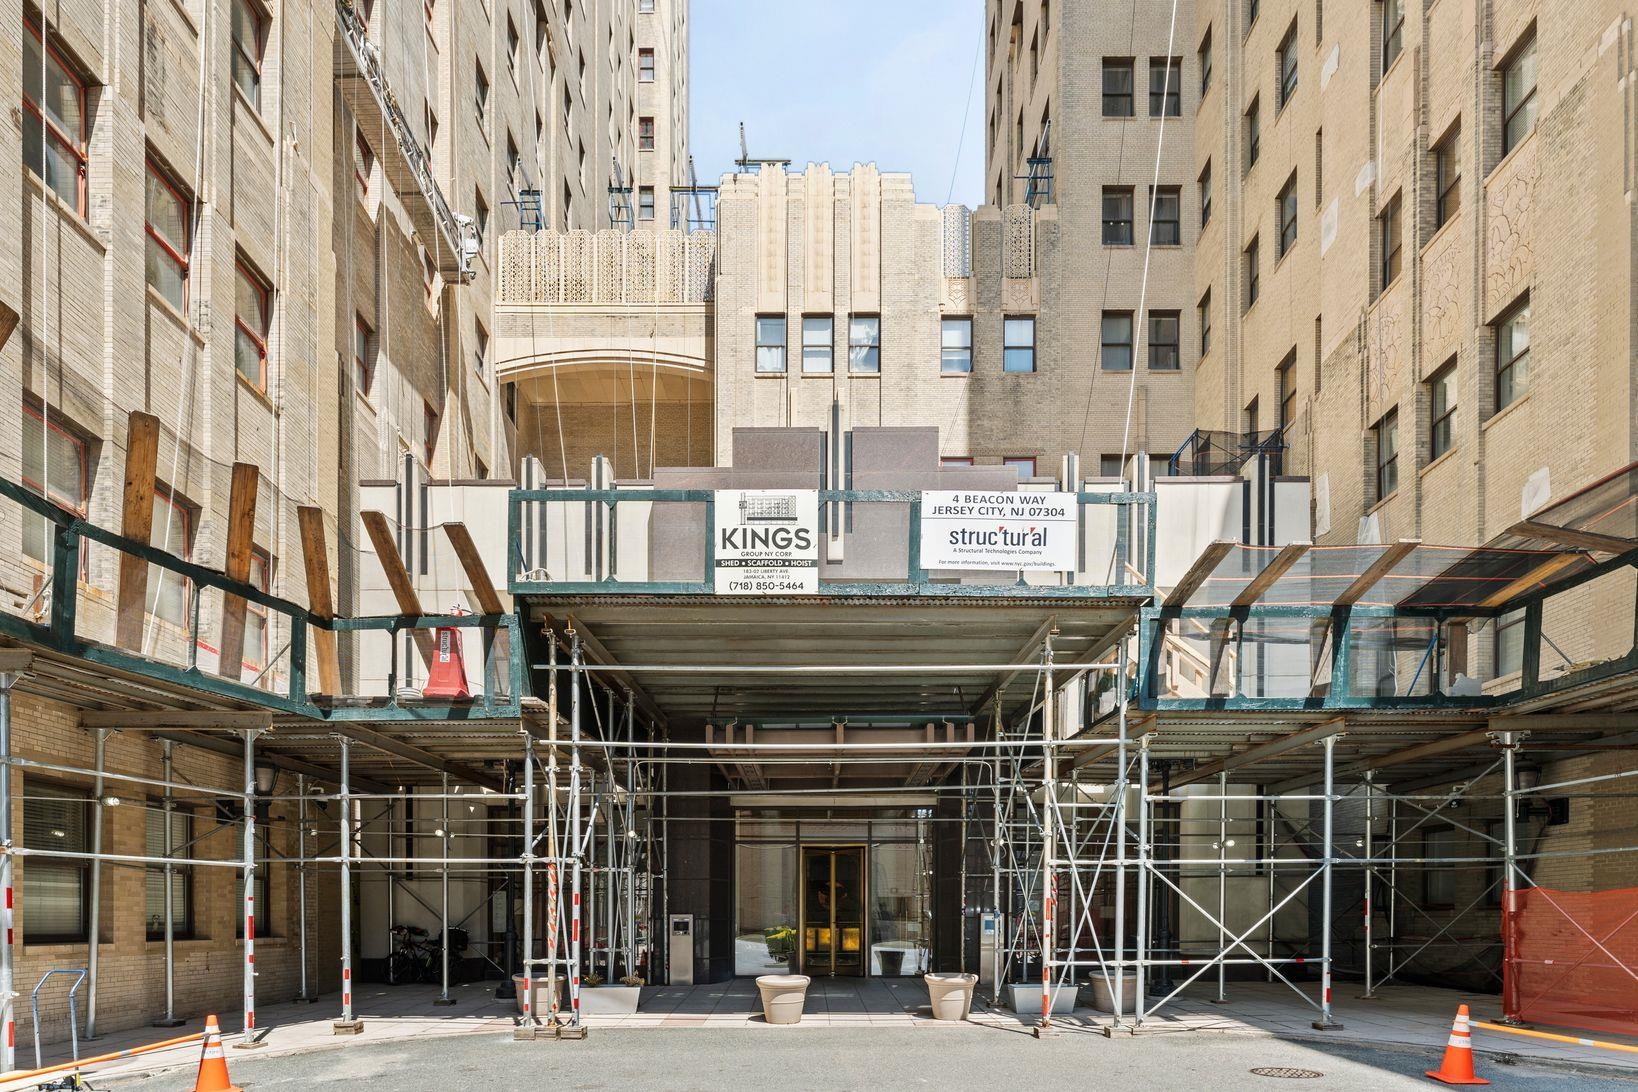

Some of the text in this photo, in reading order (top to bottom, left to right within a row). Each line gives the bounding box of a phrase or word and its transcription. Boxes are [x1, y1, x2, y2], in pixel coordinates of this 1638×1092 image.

[952, 494, 1047, 505] 4 BEACON WAY
[932, 506, 1065, 517] JERSEY CITY, NJ 07304
[722, 528, 811, 550] KINGS
[747, 559, 783, 567] SCAFFOLD
[790, 559, 812, 567] HOIST
[729, 581, 804, 591] (718) 850-5464
